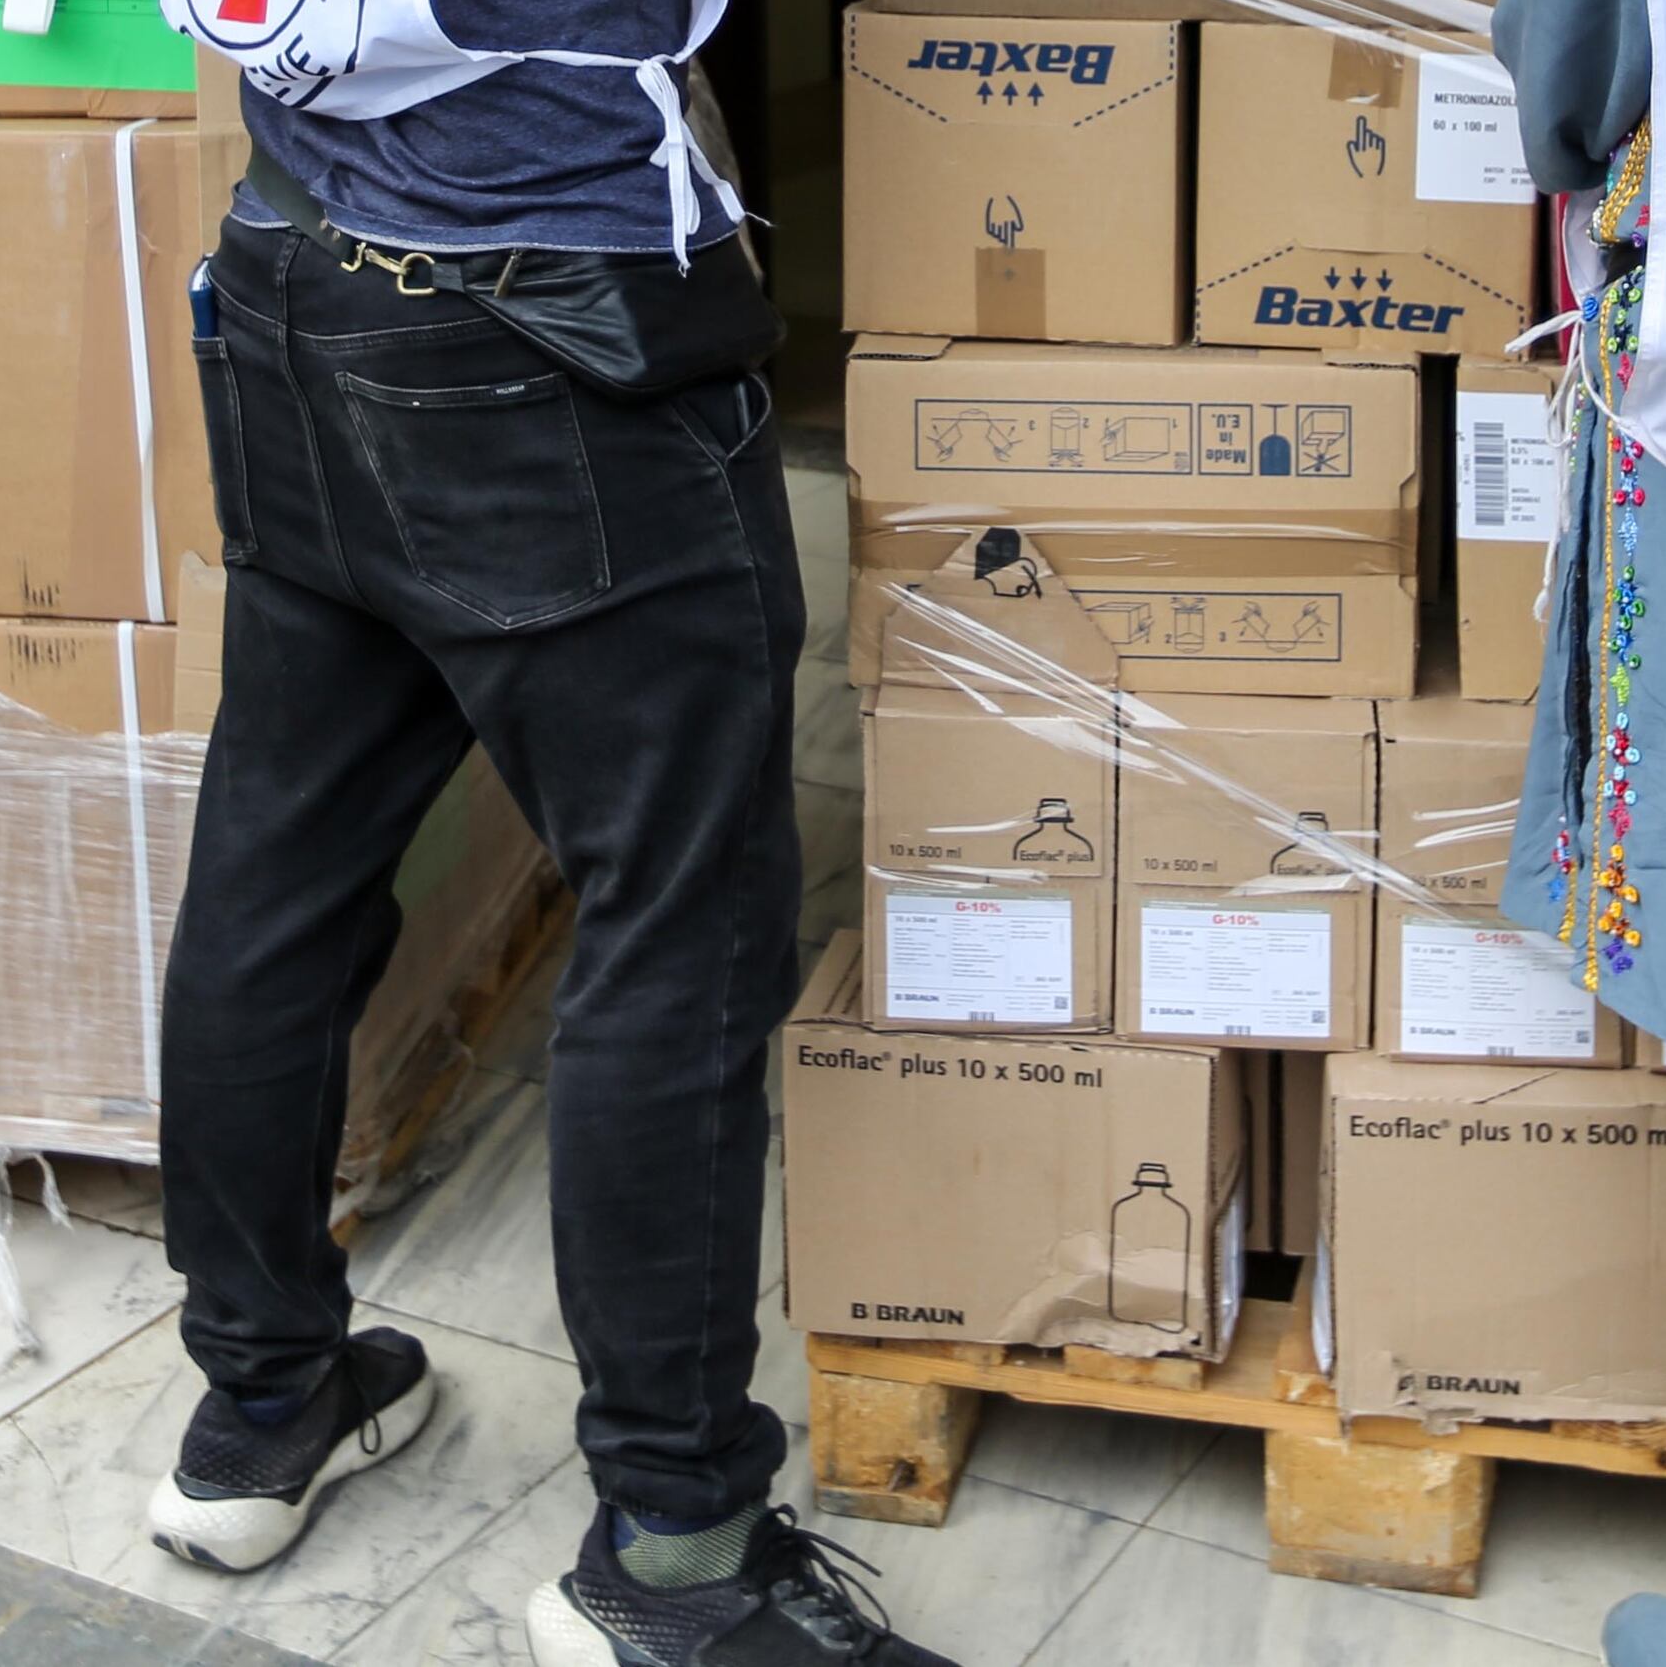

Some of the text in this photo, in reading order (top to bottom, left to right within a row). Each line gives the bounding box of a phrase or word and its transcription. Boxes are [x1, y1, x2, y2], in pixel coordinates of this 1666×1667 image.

[907, 39, 1116, 85] Baxter
[1433, 120, 1446, 130] 60
[1464, 122, 1482, 132] 100
[1485, 123, 1497, 132] ml
[1253, 286, 1465, 336] Baxter
[1211, 414, 1240, 428] E.U.
[1219, 432, 1233, 445] in
[1206, 449, 1246, 463] Made
[889, 844, 962, 858] 10 x 500 ml
[1144, 858, 1217, 872] 10 x 500 ml
[1442, 877, 1466, 889] 500
[1471, 877, 1487, 889] ml
[955, 901, 1002, 913] G-10%
[1213, 914, 1259, 926] G-10%
[901, 1052, 947, 1078] plus
[958, 1058, 986, 1079] 10
[995, 1065, 1009, 1080] x
[1018, 1063, 1065, 1084] 500
[1074, 1068, 1103, 1088] ml
[1460, 1119, 1510, 1146] plus
[1523, 1122, 1552, 1143] 10
[1561, 1128, 1577, 1143] x
[1586, 1124, 1638, 1145] 500
[851, 1302, 965, 1326] B BRAUN
[1427, 1375, 1520, 1396] BRAUN
